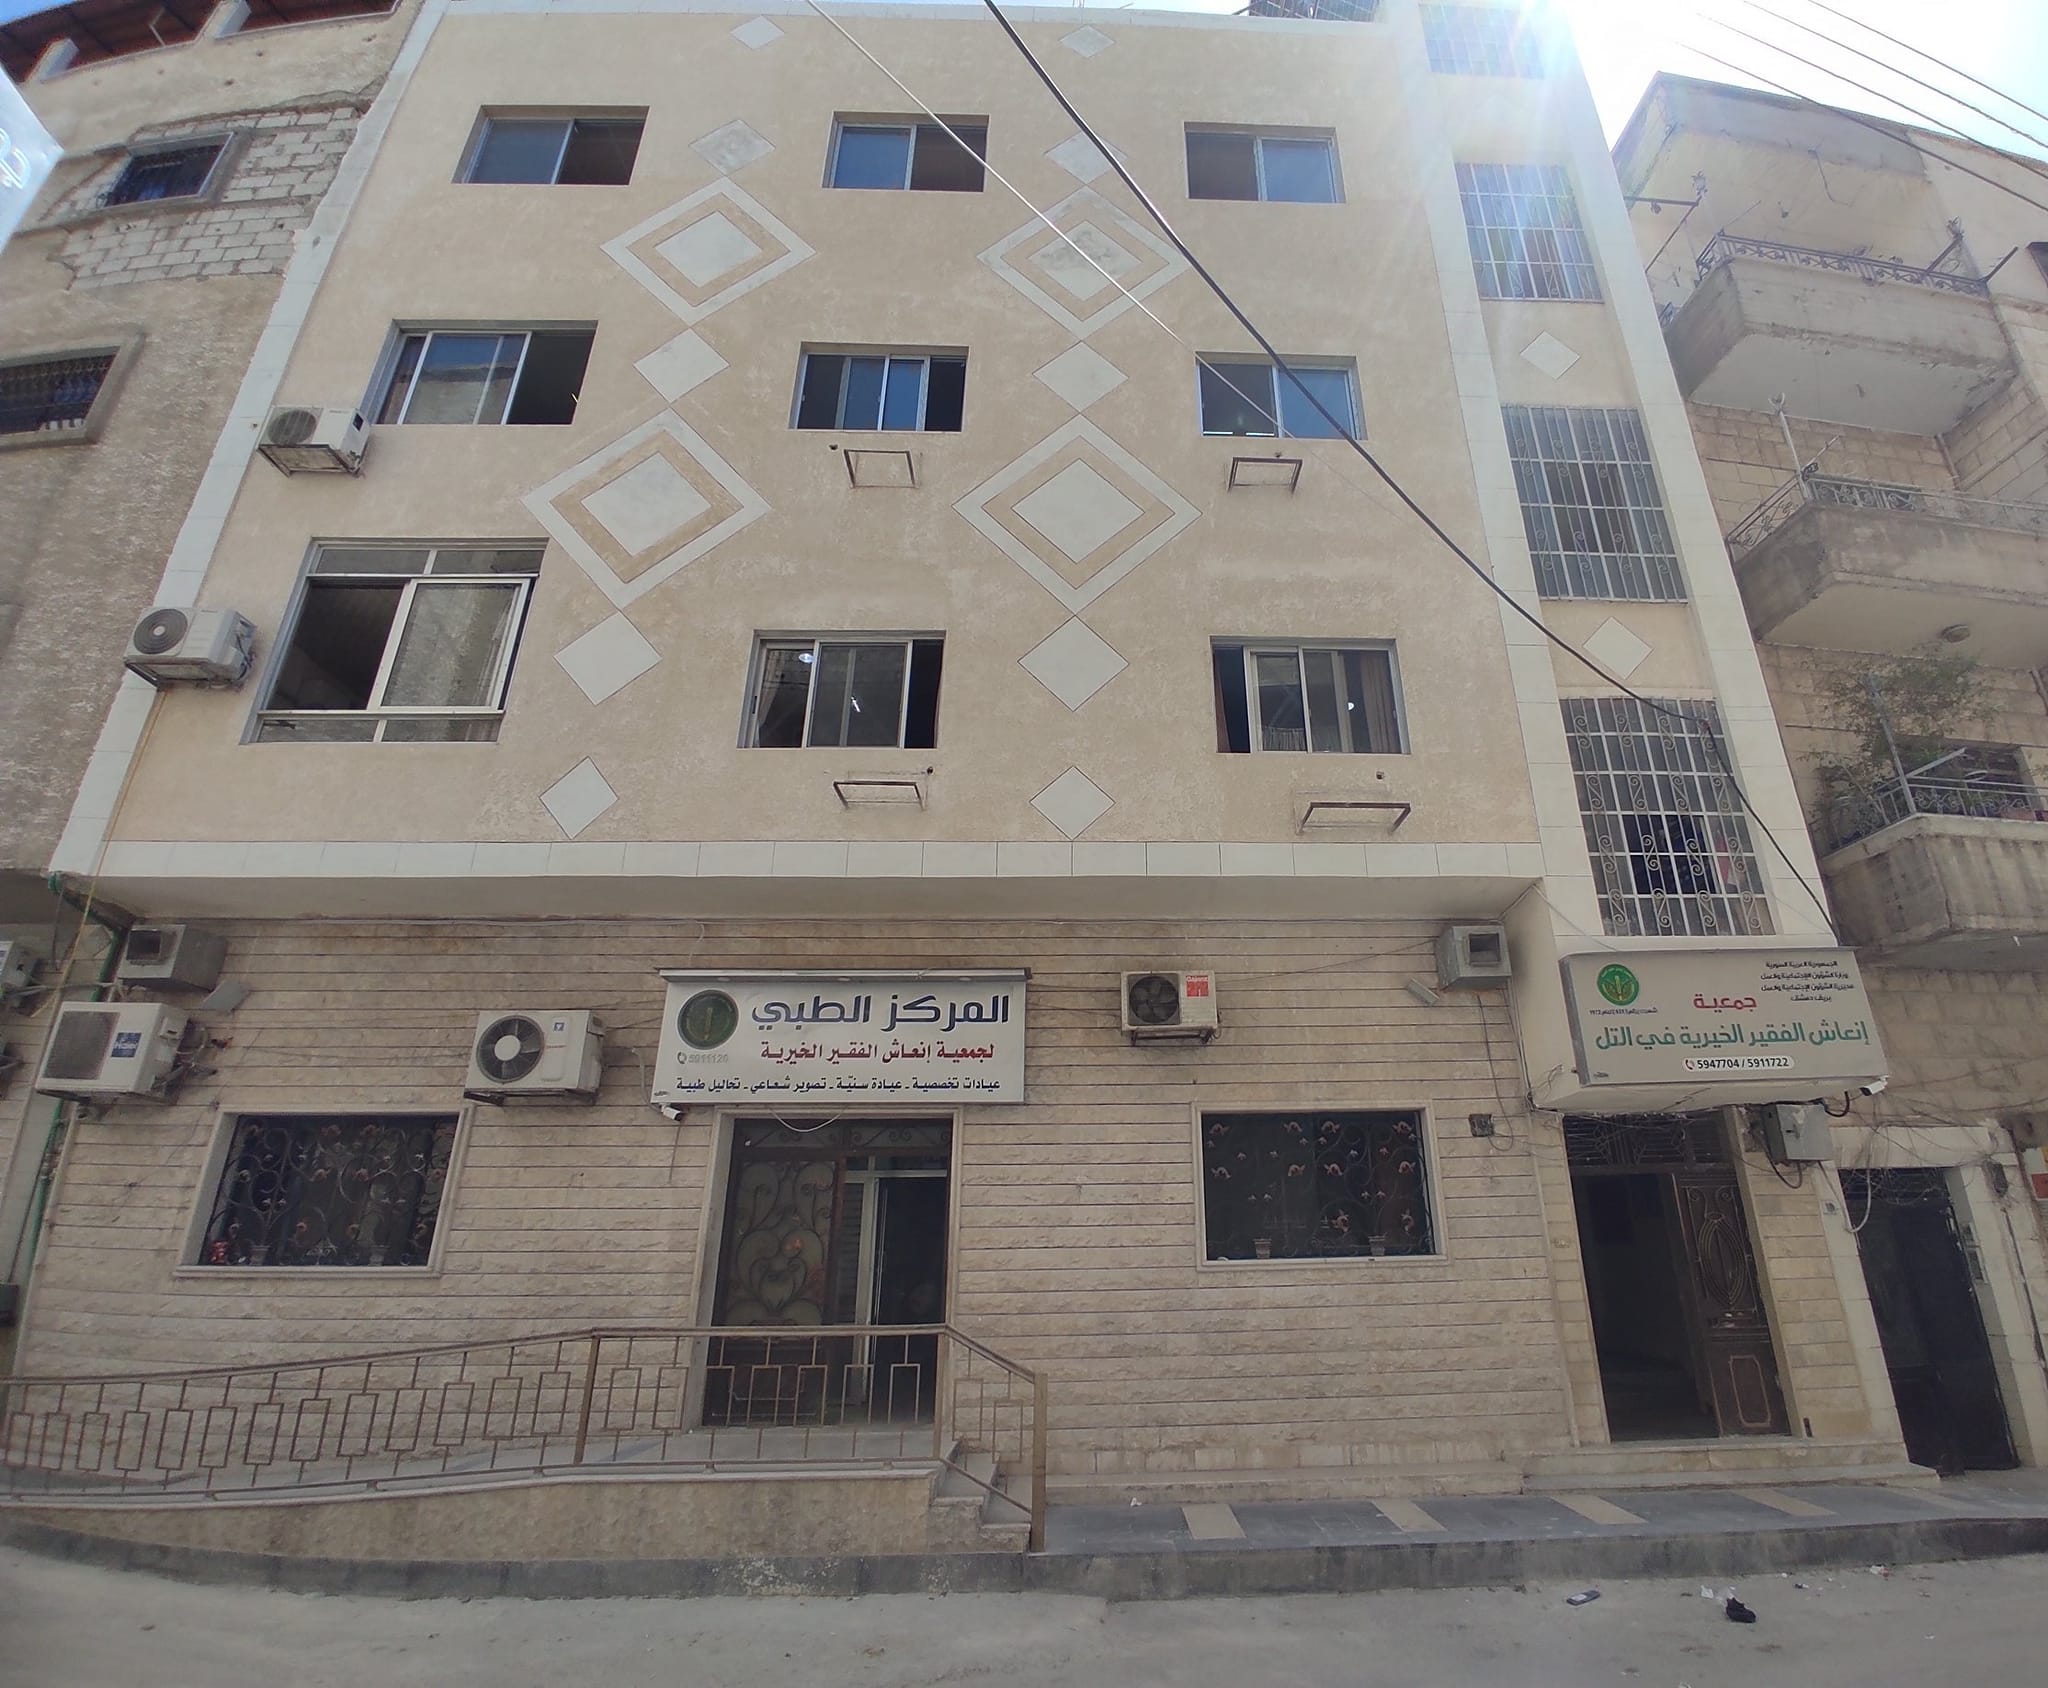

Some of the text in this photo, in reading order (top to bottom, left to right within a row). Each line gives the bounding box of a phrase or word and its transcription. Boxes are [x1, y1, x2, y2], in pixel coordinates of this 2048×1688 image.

[752, 991, 872, 1031] الطبي
[881, 990, 1010, 1032] المركز
[1693, 993, 1757, 1013] جمعية
[1595, 1019, 1871, 1050] إنعاش الفقير الخيرية في التل
[761, 1039, 995, 1065] لجمعية إنعاش الفقير الخيرية
[1697, 1058, 1740, 1069] 5947704
[1748, 1057, 1790, 1068] 5911722
[676, 1077, 705, 1092] طبية
[708, 1077, 740, 1092] تحاليل
[750, 1074, 790, 1094] شعاعي
[792, 1077, 827, 1092] تصوير
[871, 1076, 902, 1092] عيادة
[912, 1075, 959, 1092] تخصصية
[963, 1077, 1001, 1092] عيادات
